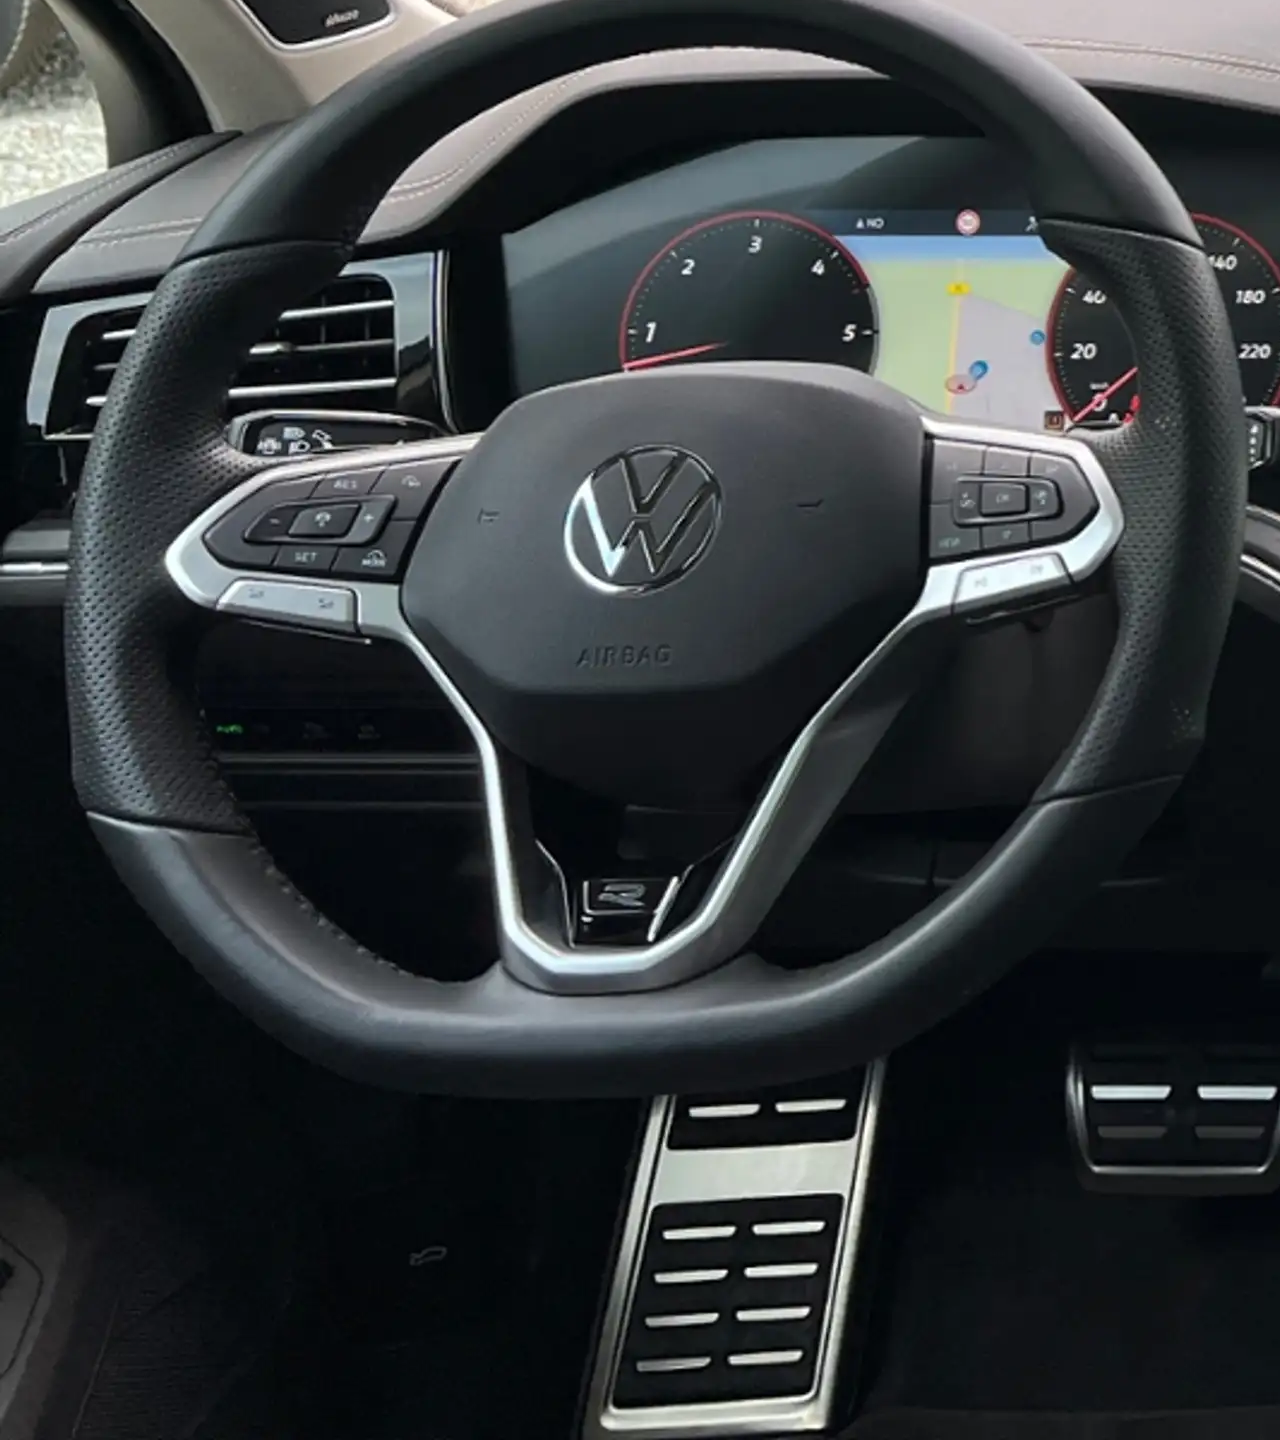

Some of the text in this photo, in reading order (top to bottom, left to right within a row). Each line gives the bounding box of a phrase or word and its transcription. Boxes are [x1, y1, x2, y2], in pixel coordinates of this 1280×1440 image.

[748, 236, 763, 253] 3
[681, 259, 695, 275] 2
[811, 260, 825, 276] 4
[1235, 289, 1267, 305] 180
[645, 321, 657, 343] 1
[842, 324, 857, 342] 5
[1070, 343, 1098, 360] 20
[1238, 343, 1272, 360] 220
[574, 643, 673, 668] AIRBAG
